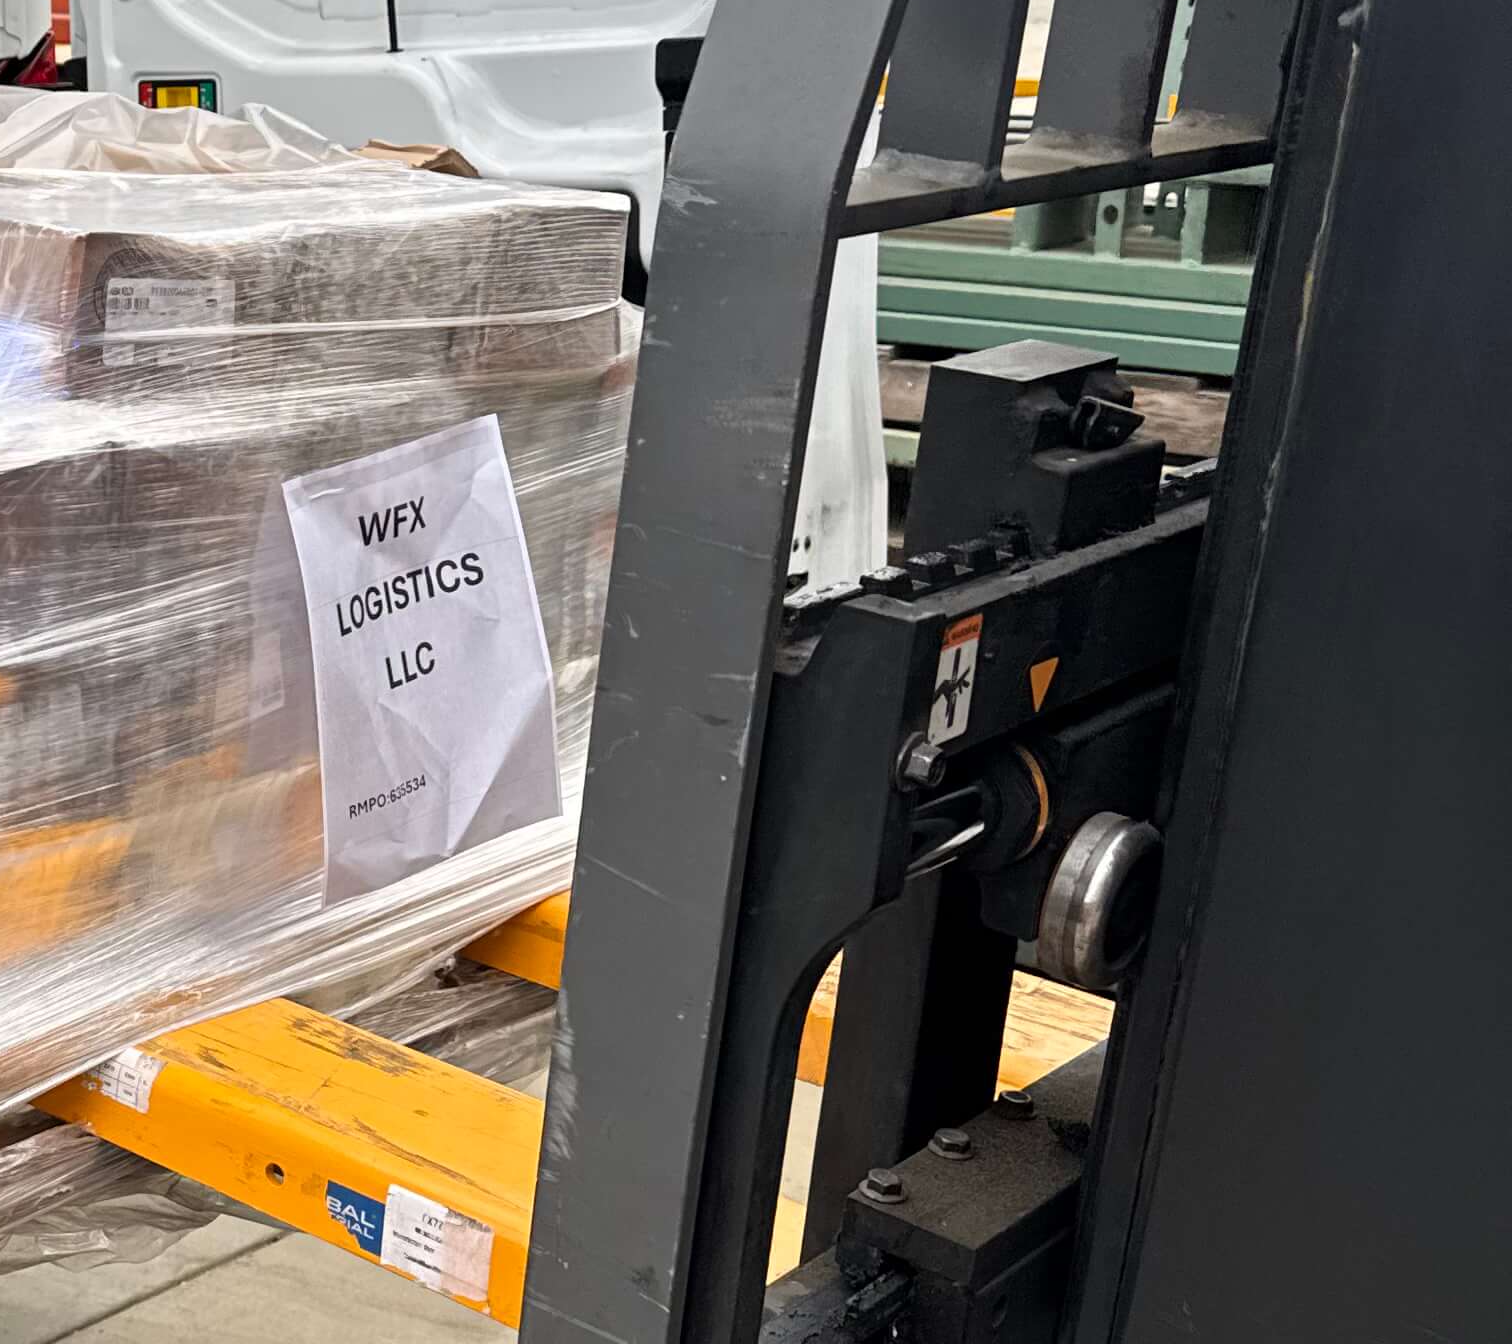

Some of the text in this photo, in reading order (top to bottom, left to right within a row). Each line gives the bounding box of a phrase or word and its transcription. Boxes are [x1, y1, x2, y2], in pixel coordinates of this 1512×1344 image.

[358, 495, 427, 547] WFX
[336, 552, 484, 637] LOGISTICS
[385, 641, 435, 689] LLC
[326, 1195, 376, 1229] BAL
